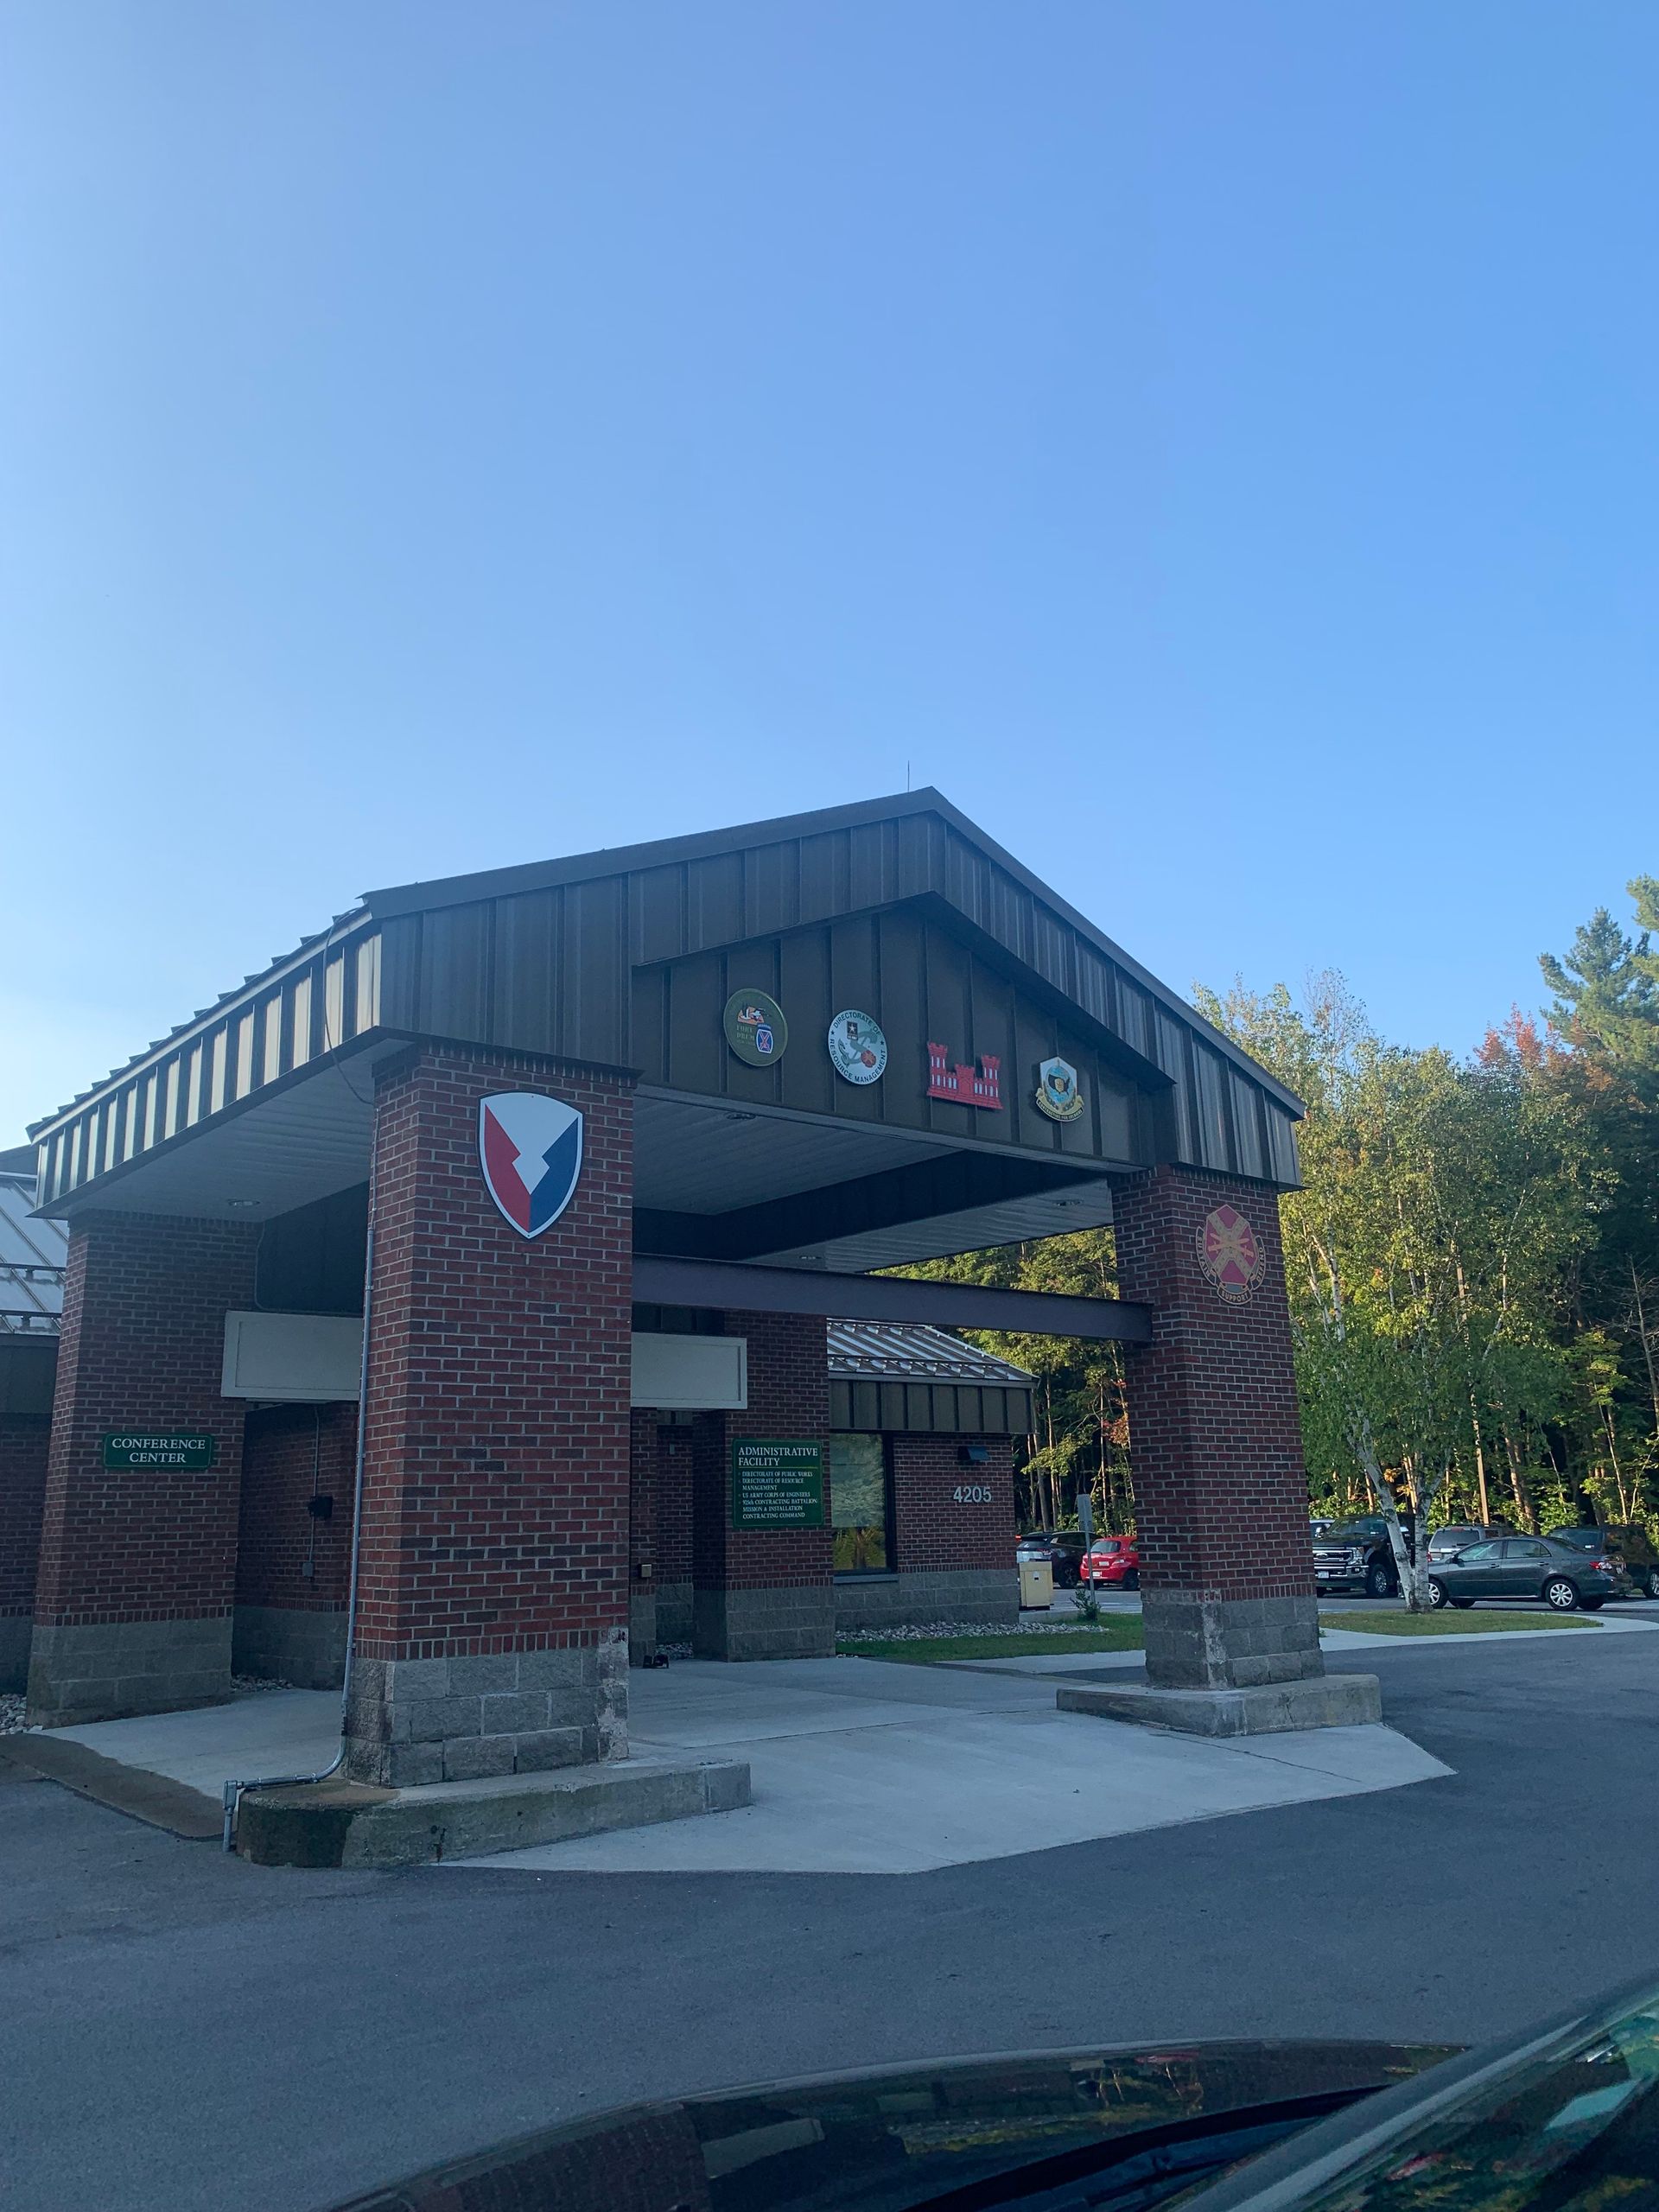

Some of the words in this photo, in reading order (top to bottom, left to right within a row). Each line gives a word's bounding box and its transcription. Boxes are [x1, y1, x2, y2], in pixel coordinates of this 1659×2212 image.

[833, 1012, 873, 1029] DIRECTORATE
[873, 1026, 881, 1036] OF
[830, 1039, 853, 1079] RESOURCE
[854, 1050, 886, 1083] MANAGEMENT
[1221, 1290, 1249, 1302] SUPPORT
[111, 1438, 206, 1450] CONFERENCE
[129, 1452, 187, 1463] CENTER
[738, 1446, 818, 1457] ADMINISTRATIVE
[738, 1457, 780, 1466] FACILITY
[953, 1486, 992, 1503] 4205
